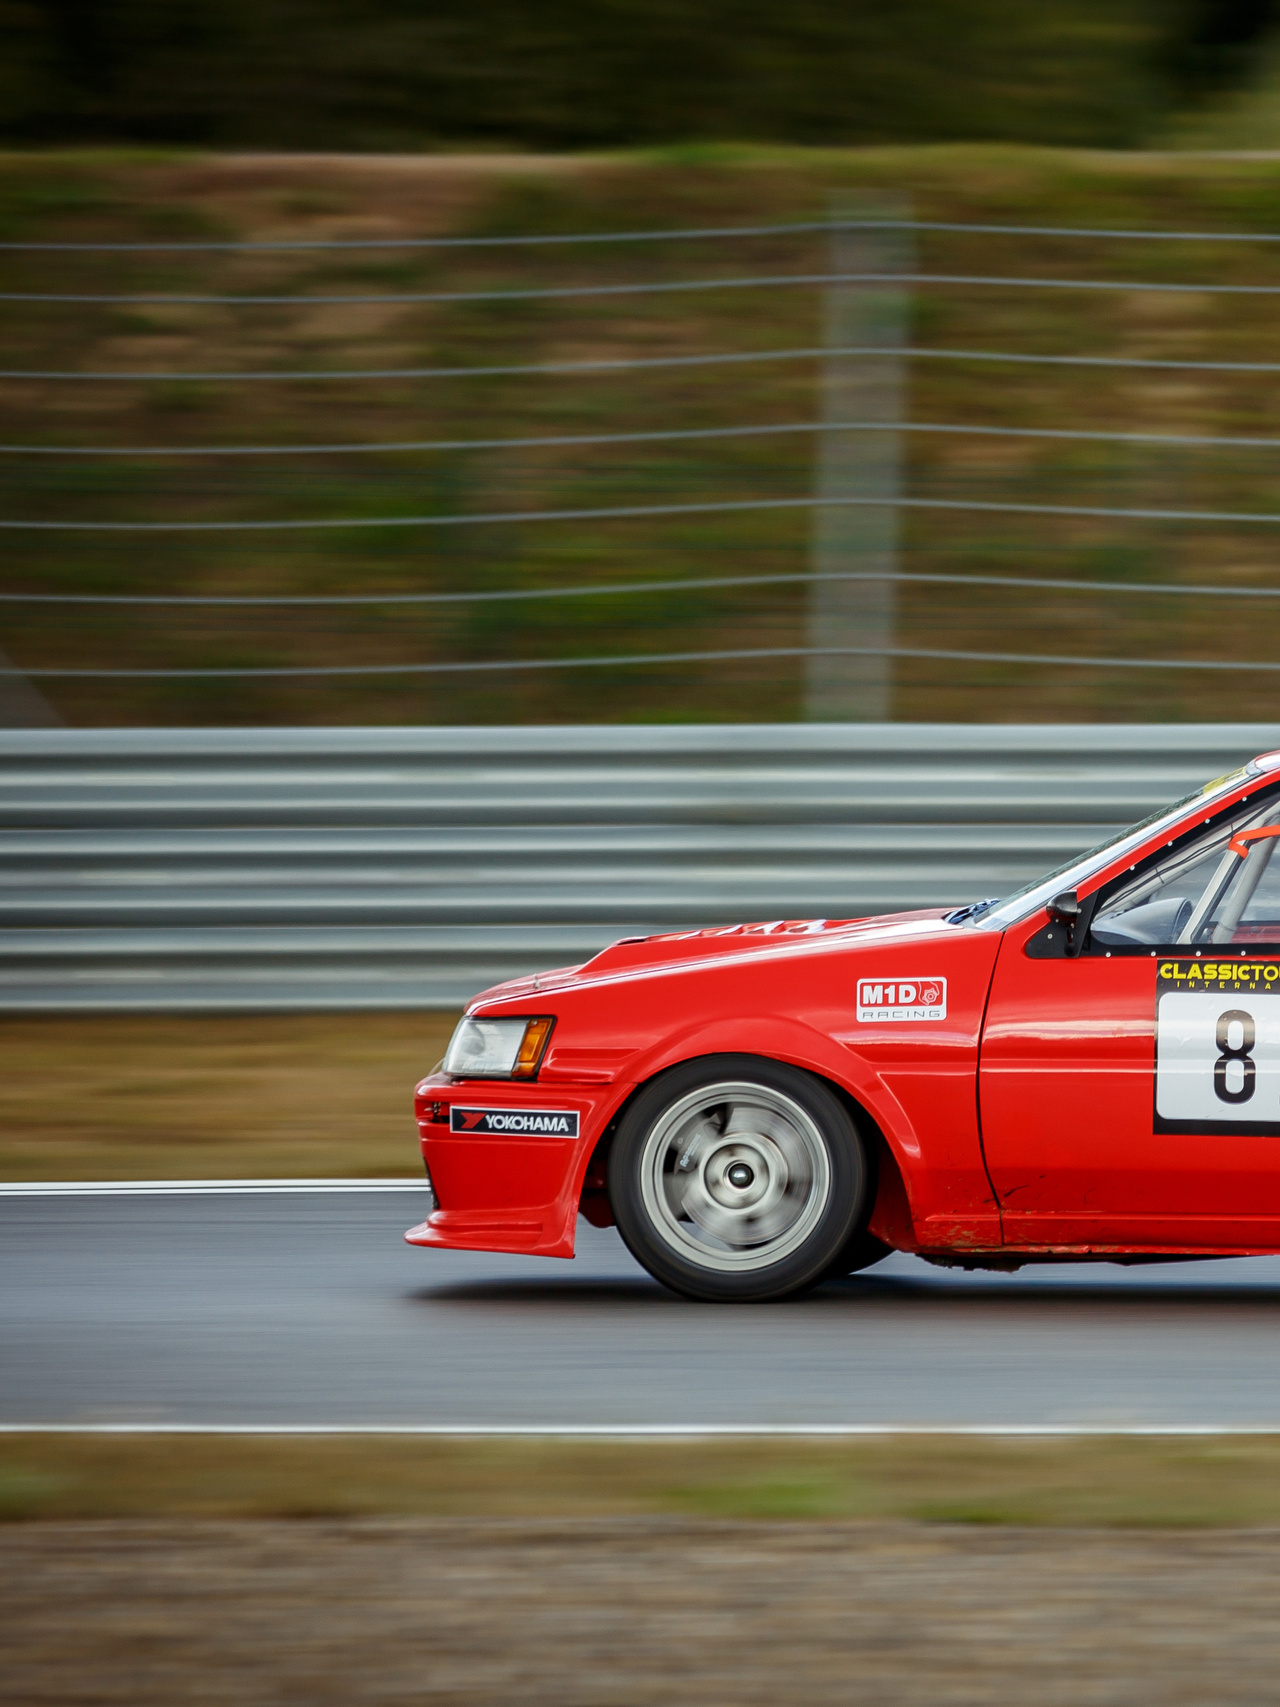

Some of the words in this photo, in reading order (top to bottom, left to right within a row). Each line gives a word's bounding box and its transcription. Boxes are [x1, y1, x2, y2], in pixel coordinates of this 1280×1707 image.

[862, 984, 917, 1004] M1D
[862, 1009, 941, 1019] RACING
[485, 1114, 569, 1132] YOKOHAMA
